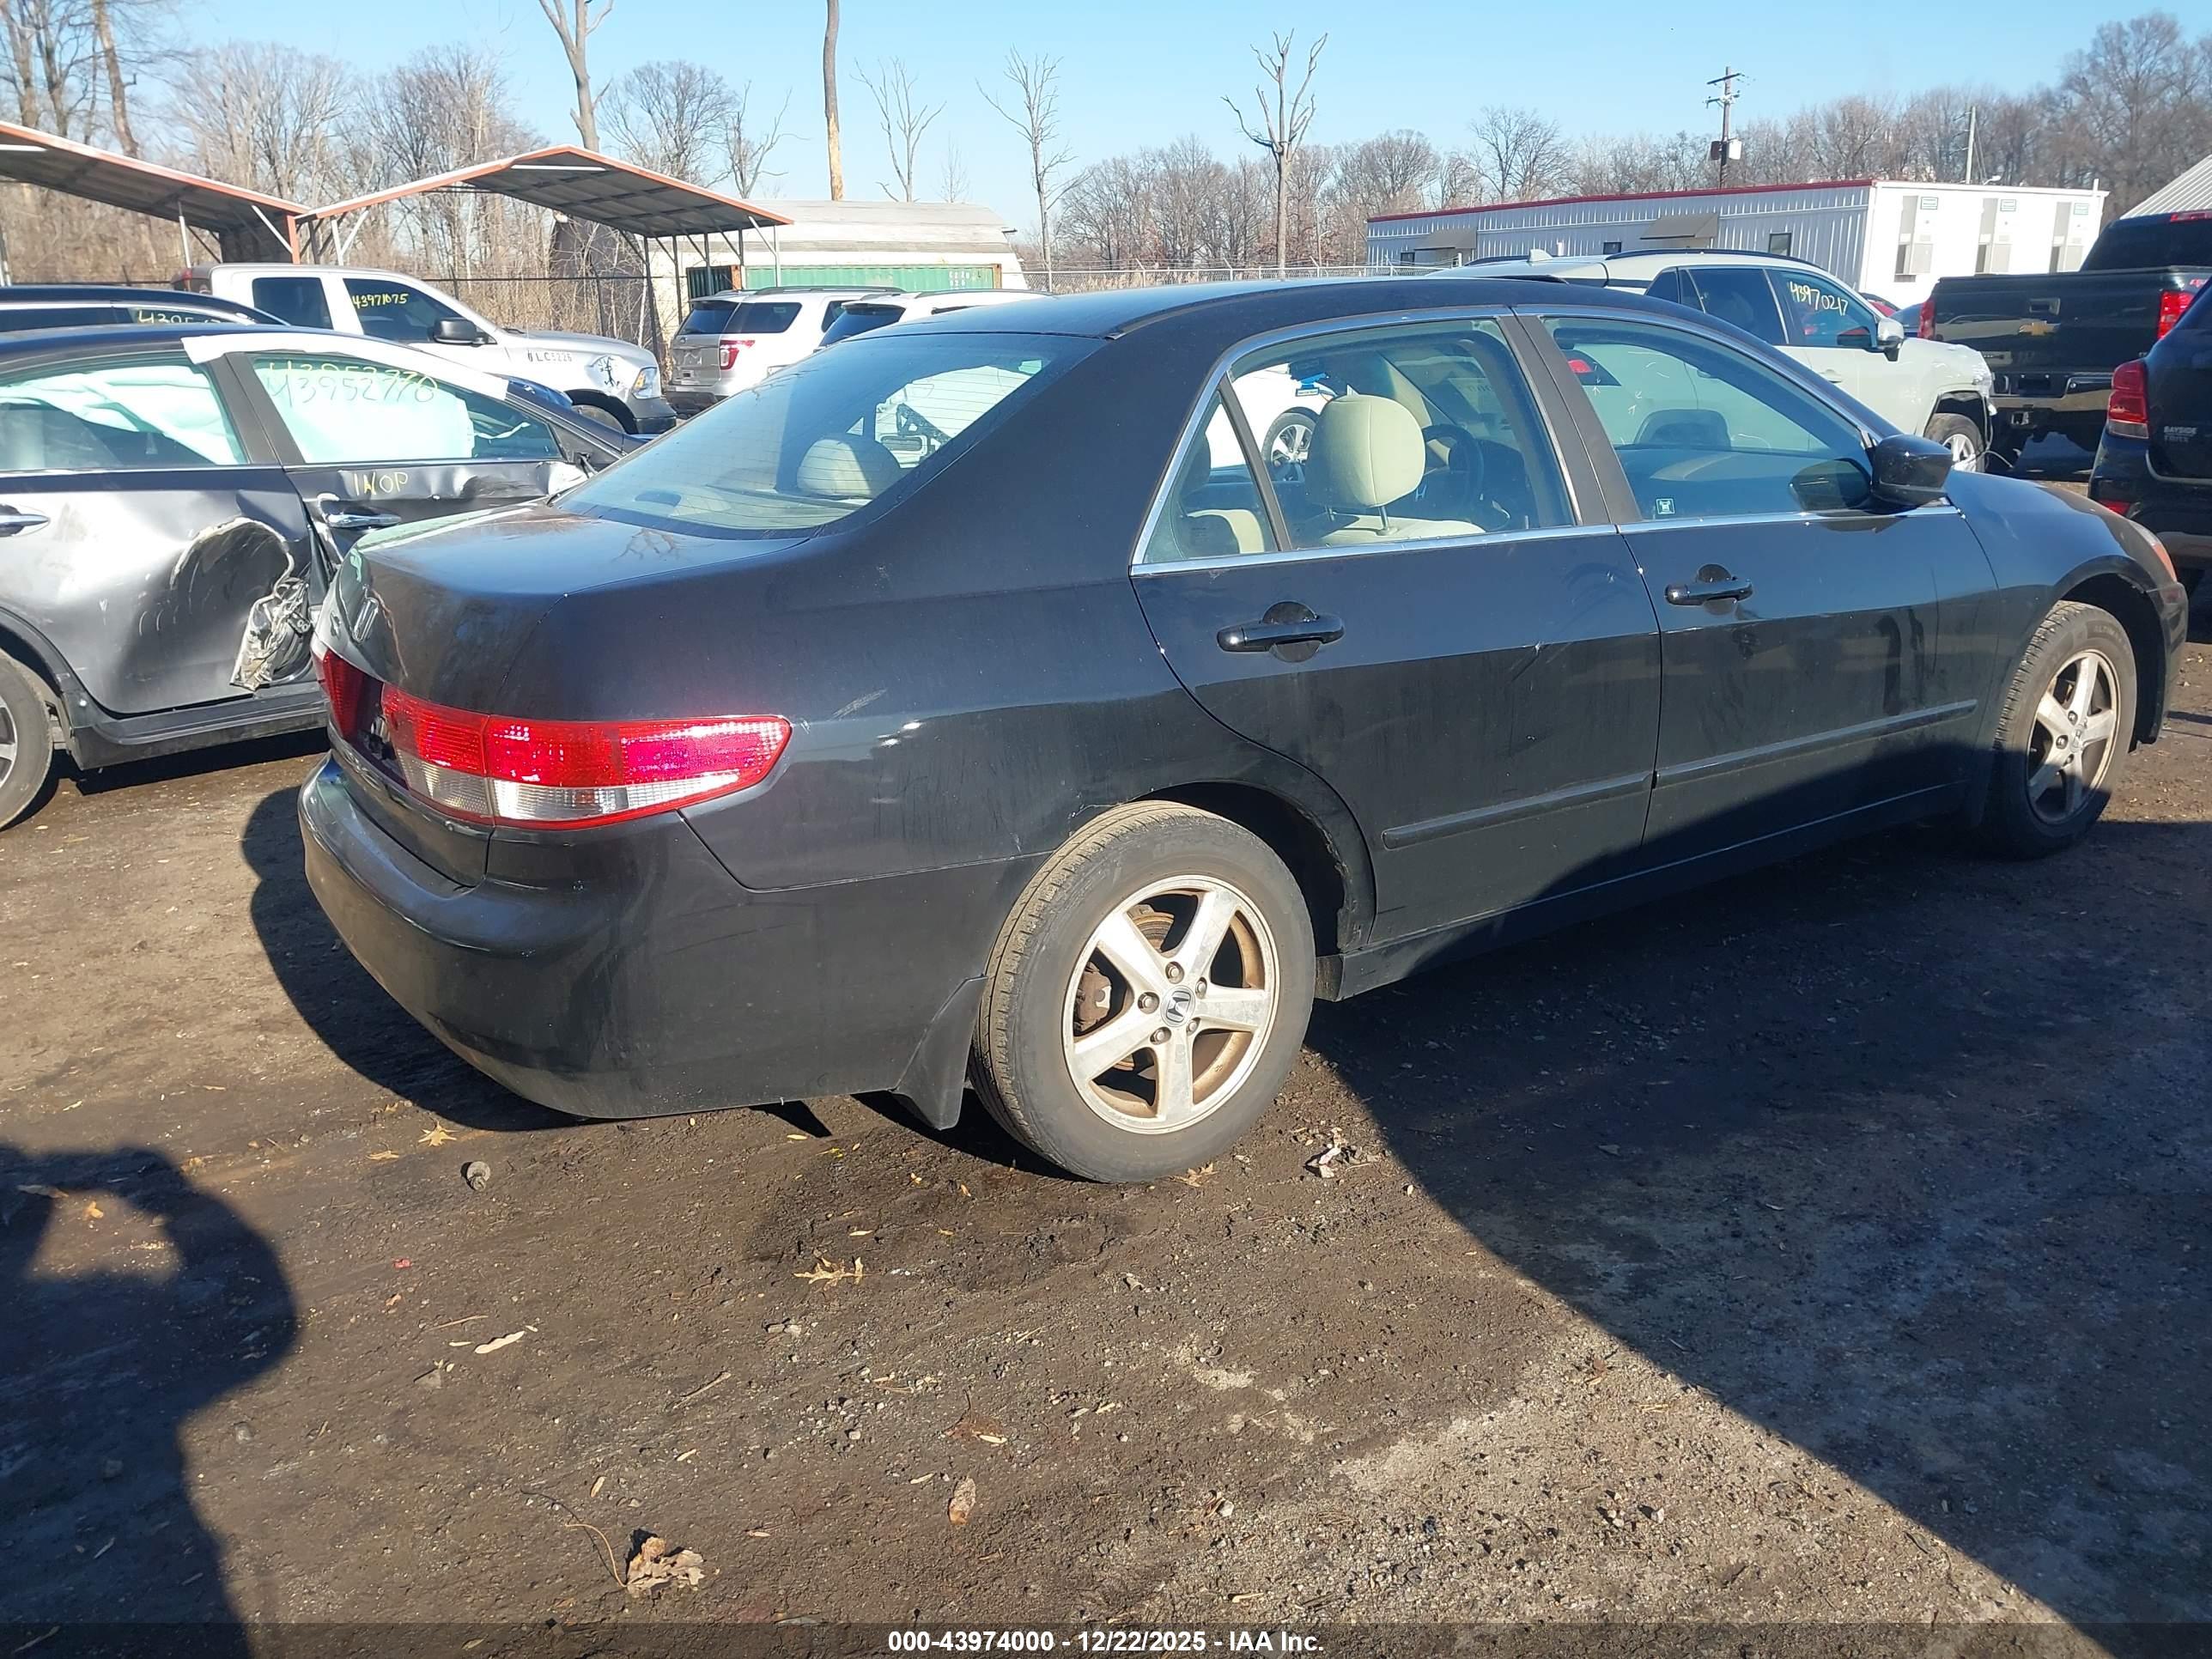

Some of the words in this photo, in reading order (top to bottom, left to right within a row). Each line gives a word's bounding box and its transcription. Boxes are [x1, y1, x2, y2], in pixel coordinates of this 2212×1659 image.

[352, 293, 409, 309] 43971075
[1787, 281, 1849, 317] 43970217
[354, 471, 409, 496] INOP
